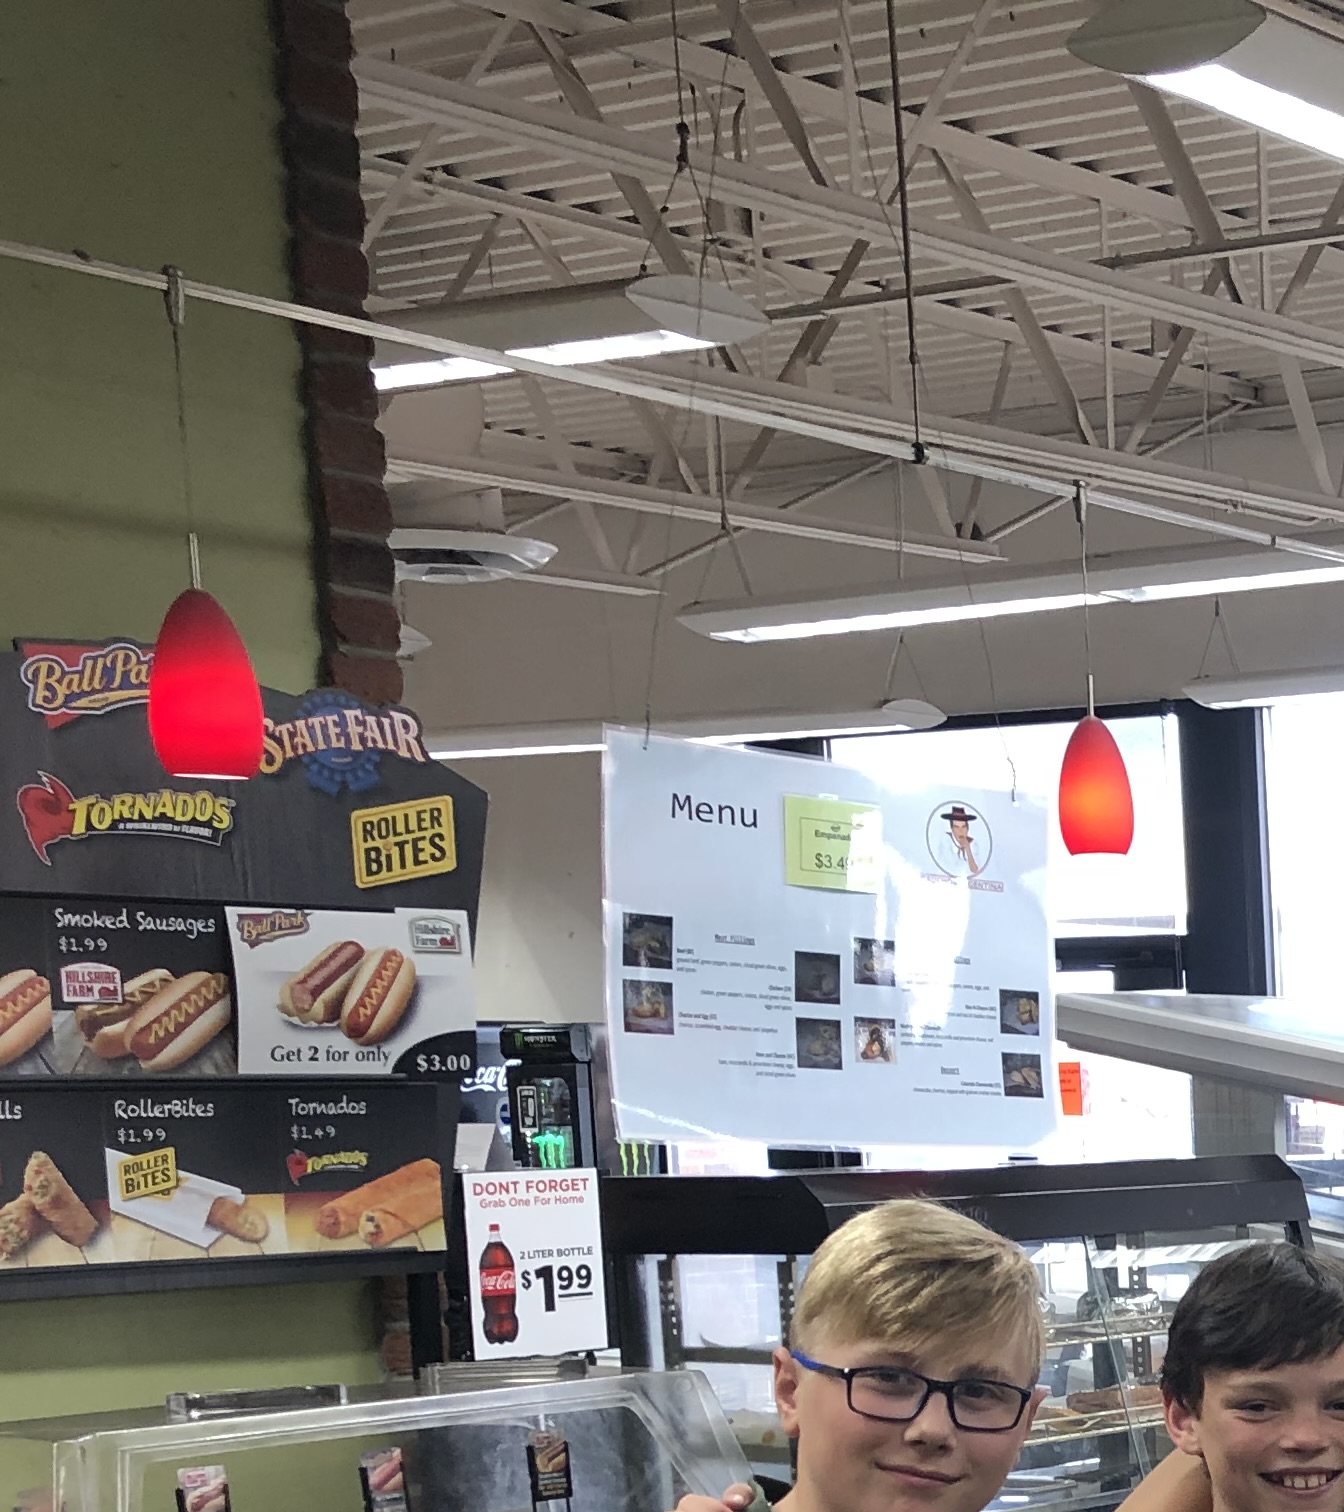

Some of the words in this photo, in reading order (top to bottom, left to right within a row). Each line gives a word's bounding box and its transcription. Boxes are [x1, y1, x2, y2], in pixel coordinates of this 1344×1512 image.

[27, 657, 104, 708] Ball
[107, 650, 150, 688] Pa
[260, 714, 345, 773] STATE
[344, 708, 426, 762] FAIR
[69, 789, 234, 834] TORNADOS
[671, 793, 758, 828] Menu
[362, 808, 442, 843] ROLLER
[815, 829, 851, 842] Empanad
[55, 908, 130, 929] Smoked
[137, 911, 216, 939] Sausages
[59, 936, 108, 953] $1.99
[271, 1045, 299, 1062] Get
[308, 1048, 319, 1062] 2
[326, 1045, 349, 1062] for
[355, 1046, 391, 1067] only
[416, 1054, 471, 1072] $3.00
[115, 1098, 214, 1119] RollerBites
[288, 1095, 367, 1115] Tornados
[117, 1128, 167, 1144] $1.99
[124, 1153, 169, 1176] ROLLER
[472, 1181, 519, 1196] DONT
[526, 1178, 589, 1194] FORGET
[480, 1198, 506, 1208] Grab
[509, 1197, 530, 1207] One
[534, 1196, 550, 1205] For
[554, 1195, 584, 1205] Home
[520, 1251, 526, 1260] 2
[528, 1249, 554, 1259] LITER
[557, 1246, 593, 1257] BOTTLE
